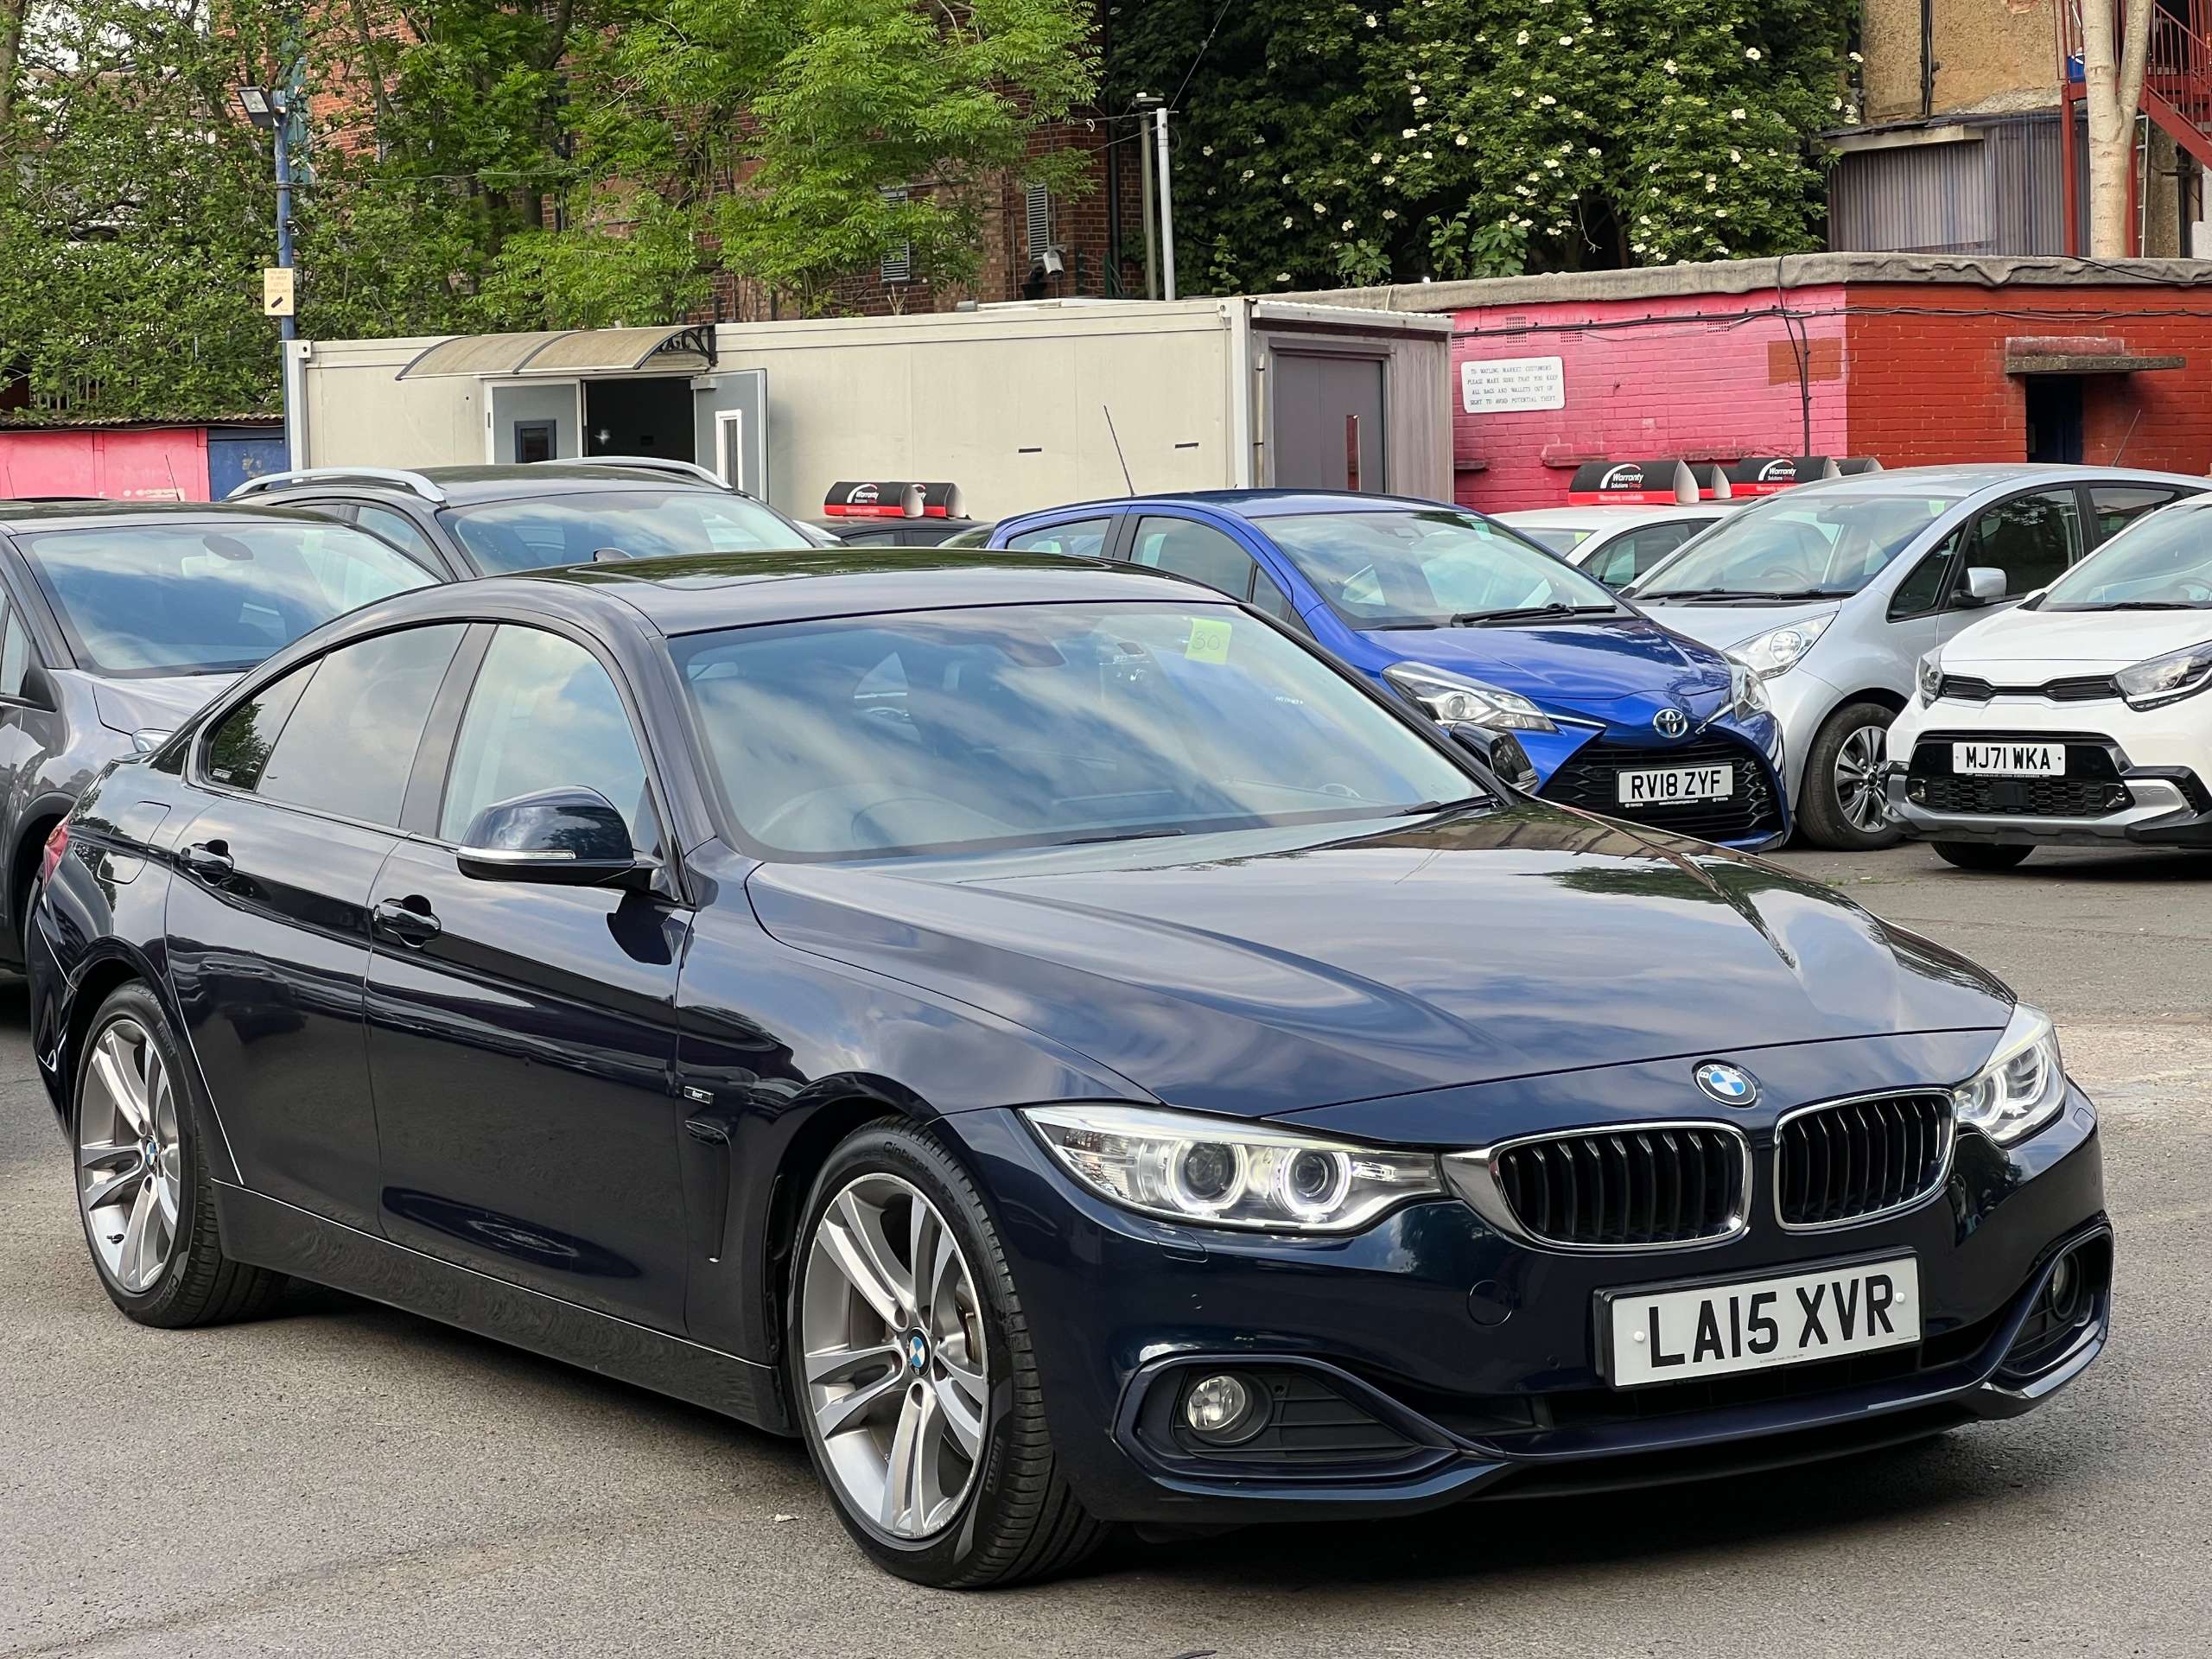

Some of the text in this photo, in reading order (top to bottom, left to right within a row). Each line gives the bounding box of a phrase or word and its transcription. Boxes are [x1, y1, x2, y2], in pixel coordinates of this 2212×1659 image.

[1612, 473, 1643, 483] Warranty
[1769, 467, 1796, 476] Warranty
[855, 491, 879, 500] Warranty
[1966, 747, 2050, 769] MJ71 WKA
[1631, 770, 1721, 799] RV18 ZYF
[1649, 1274, 1895, 1368] LA15 XVR
